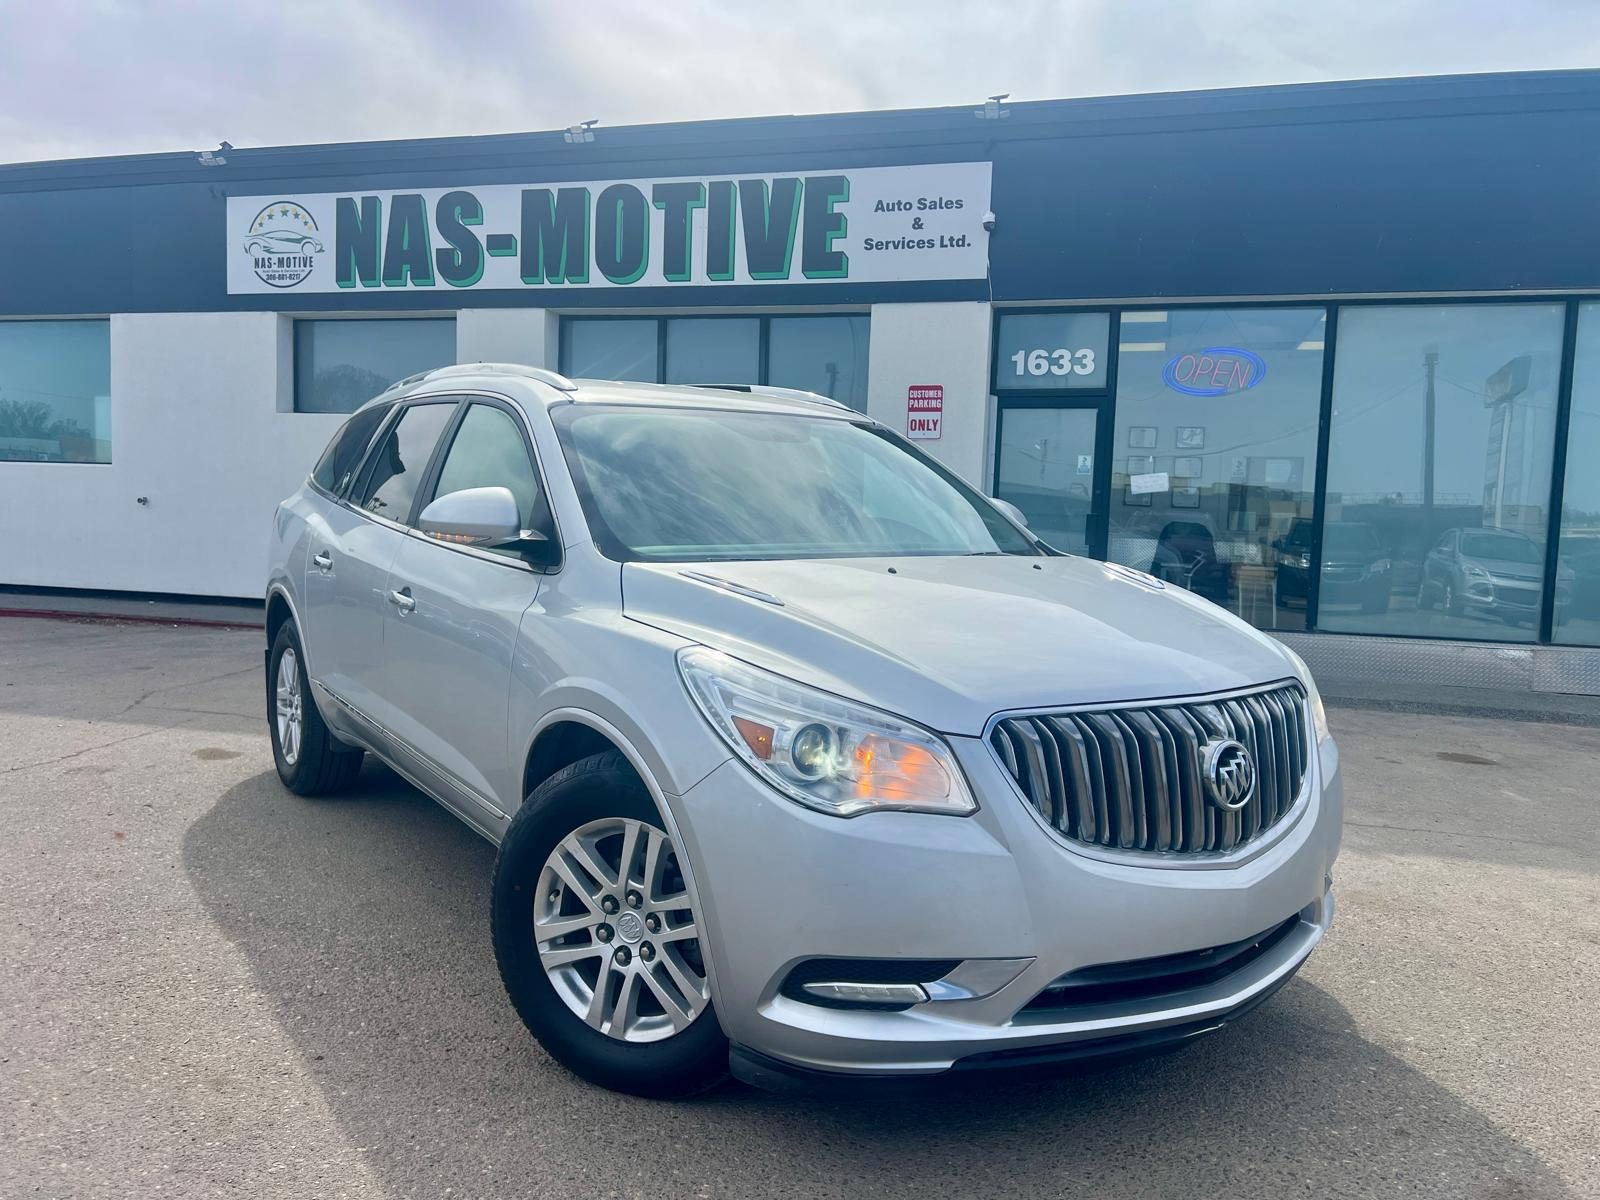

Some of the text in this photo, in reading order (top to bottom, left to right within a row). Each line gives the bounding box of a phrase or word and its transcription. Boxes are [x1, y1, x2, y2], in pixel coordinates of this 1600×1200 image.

[873, 197, 964, 213] Auto Sales
[911, 216, 925, 231] &
[335, 174, 850, 289] NAS-MOTIVE
[863, 234, 972, 251] Services Ltd.
[254, 255, 314, 269] NAS-MOTIVE
[1011, 348, 1096, 376] 1633
[1174, 354, 1251, 389] OPEN
[909, 389, 942, 398] CUSTOMER
[909, 399, 942, 408] PARKING
[910, 418, 939, 431] ONLY
